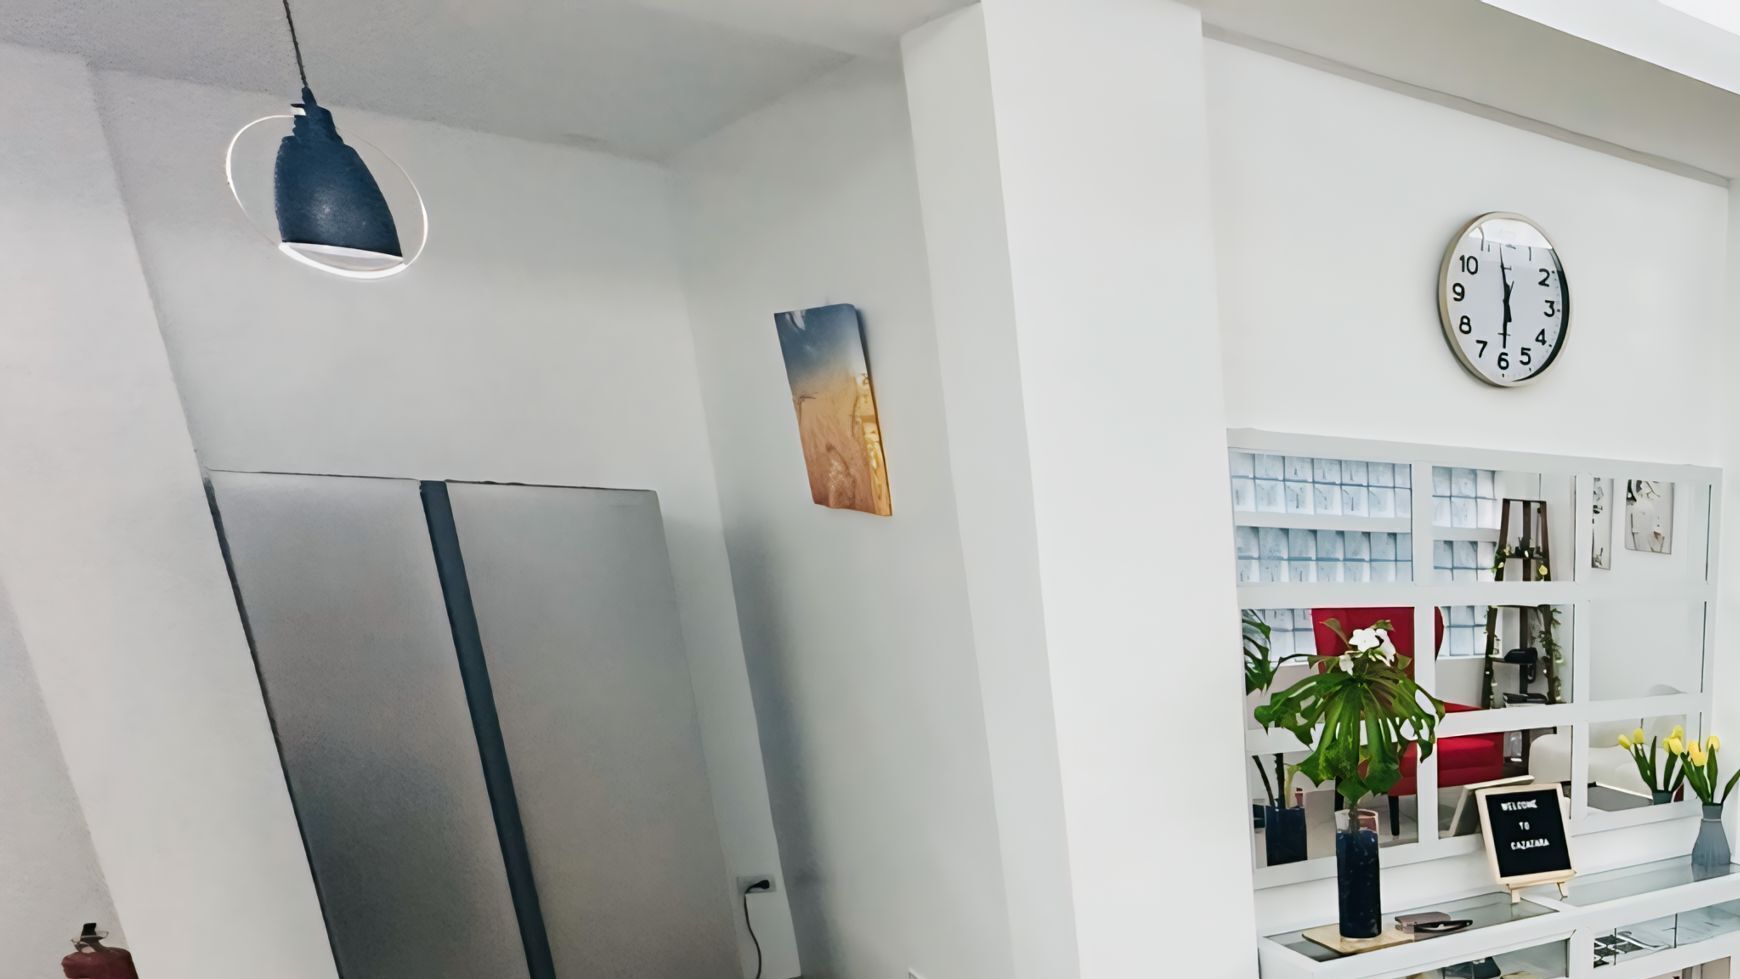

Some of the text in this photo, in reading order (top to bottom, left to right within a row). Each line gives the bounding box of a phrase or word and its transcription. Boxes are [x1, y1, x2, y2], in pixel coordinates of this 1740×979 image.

[1459, 254, 1478, 275] 10
[1538, 268, 1550, 287] 2
[1452, 282, 1465, 302] 9
[1543, 300, 1555, 317] 3
[1459, 315, 1472, 334] 8
[1535, 328, 1547, 346] 4
[1475, 339, 1488, 358] 7
[1520, 347, 1532, 366] 5
[1497, 352, 1509, 370] 6
[1500, 799, 1538, 811] WELCOME
[1518, 821, 1530, 831] TO
